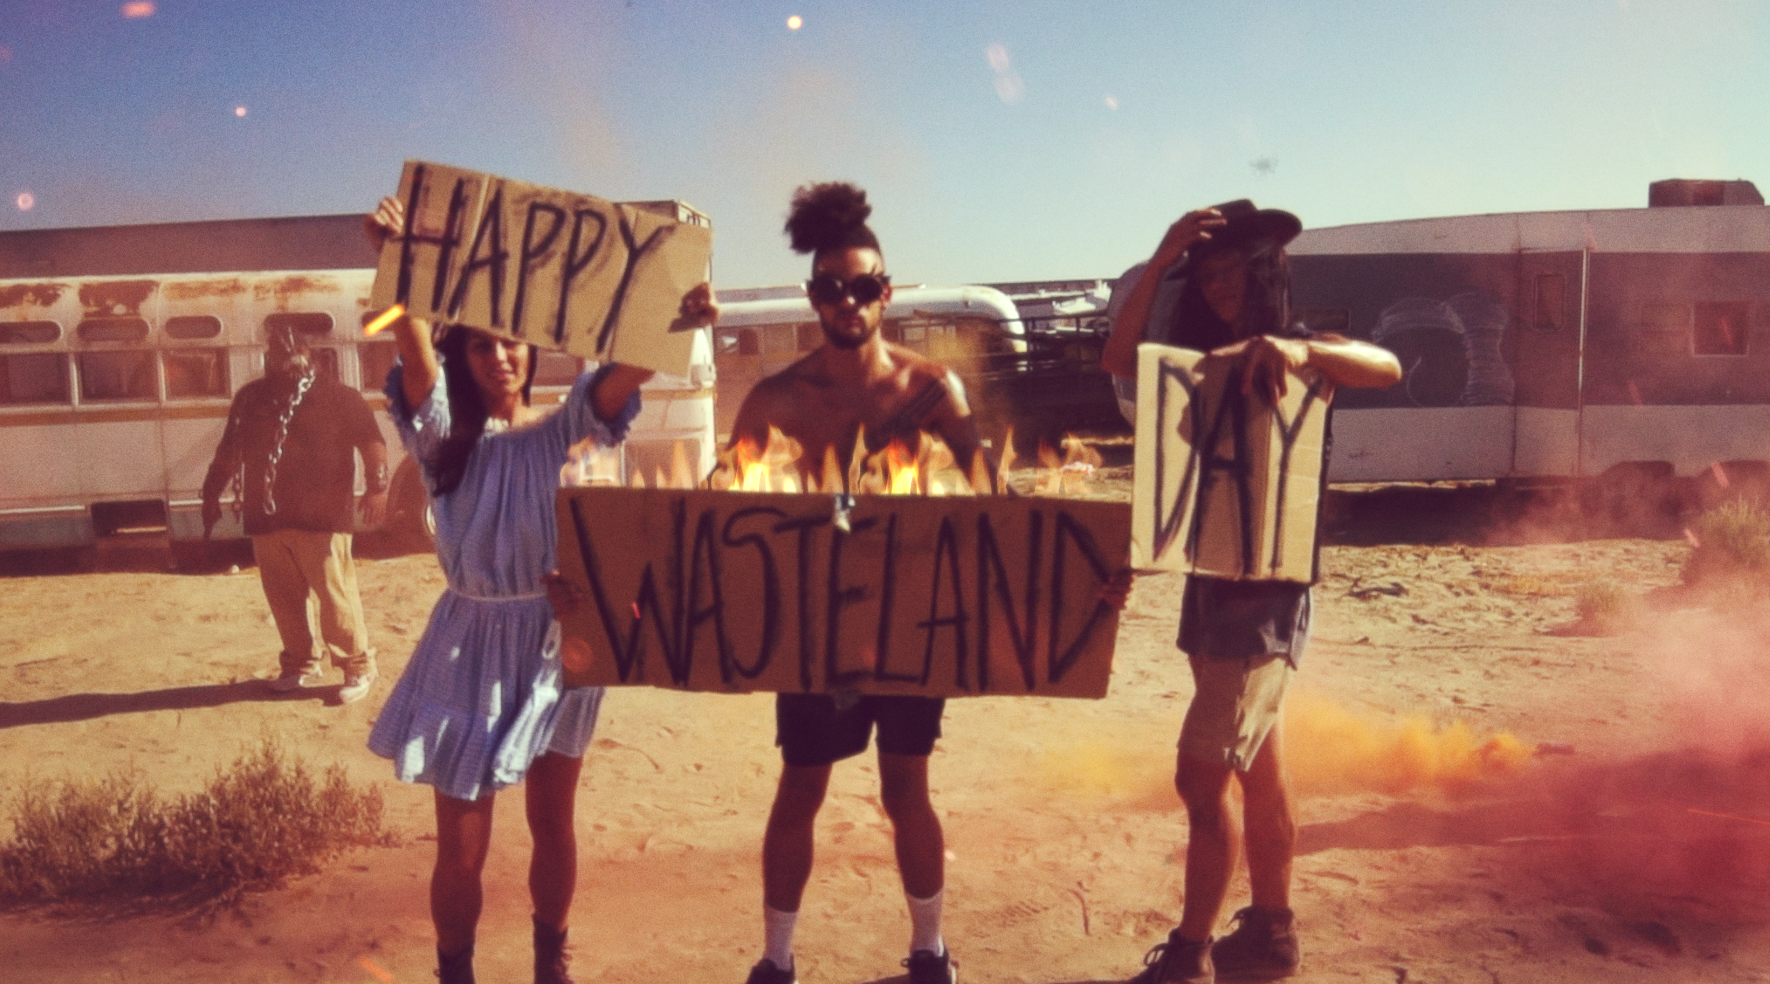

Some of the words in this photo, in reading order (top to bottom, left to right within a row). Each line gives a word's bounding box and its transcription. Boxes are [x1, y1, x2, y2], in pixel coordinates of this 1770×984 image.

[390, 164, 676, 354] HAPPY
[1153, 357, 1325, 573] DAY
[569, 497, 1112, 693] WASTELAND
